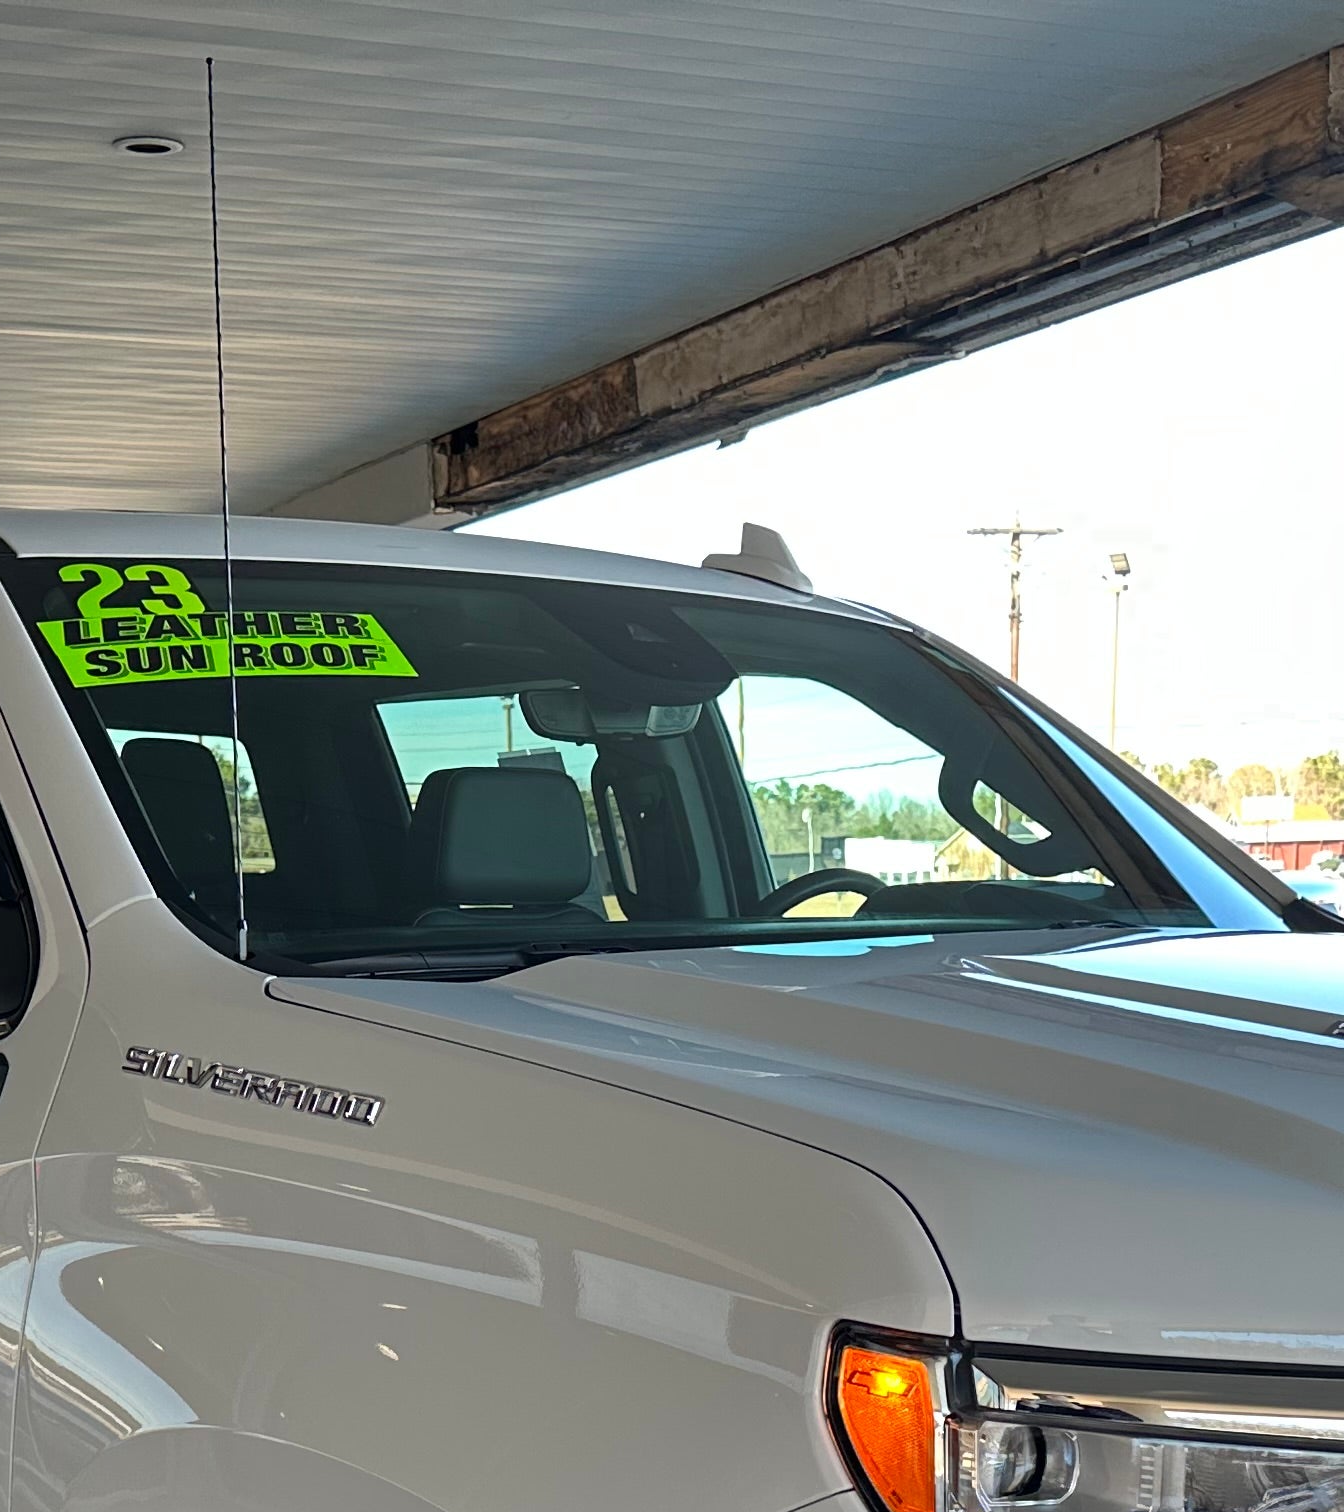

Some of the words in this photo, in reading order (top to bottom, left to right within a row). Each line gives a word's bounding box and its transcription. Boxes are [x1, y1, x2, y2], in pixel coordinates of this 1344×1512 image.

[58, 563, 205, 618] 23
[63, 612, 374, 648] LEATHER
[84, 644, 216, 679] SUN
[234, 641, 388, 673] ROOF
[122, 1046, 386, 1126] SILVERADO
